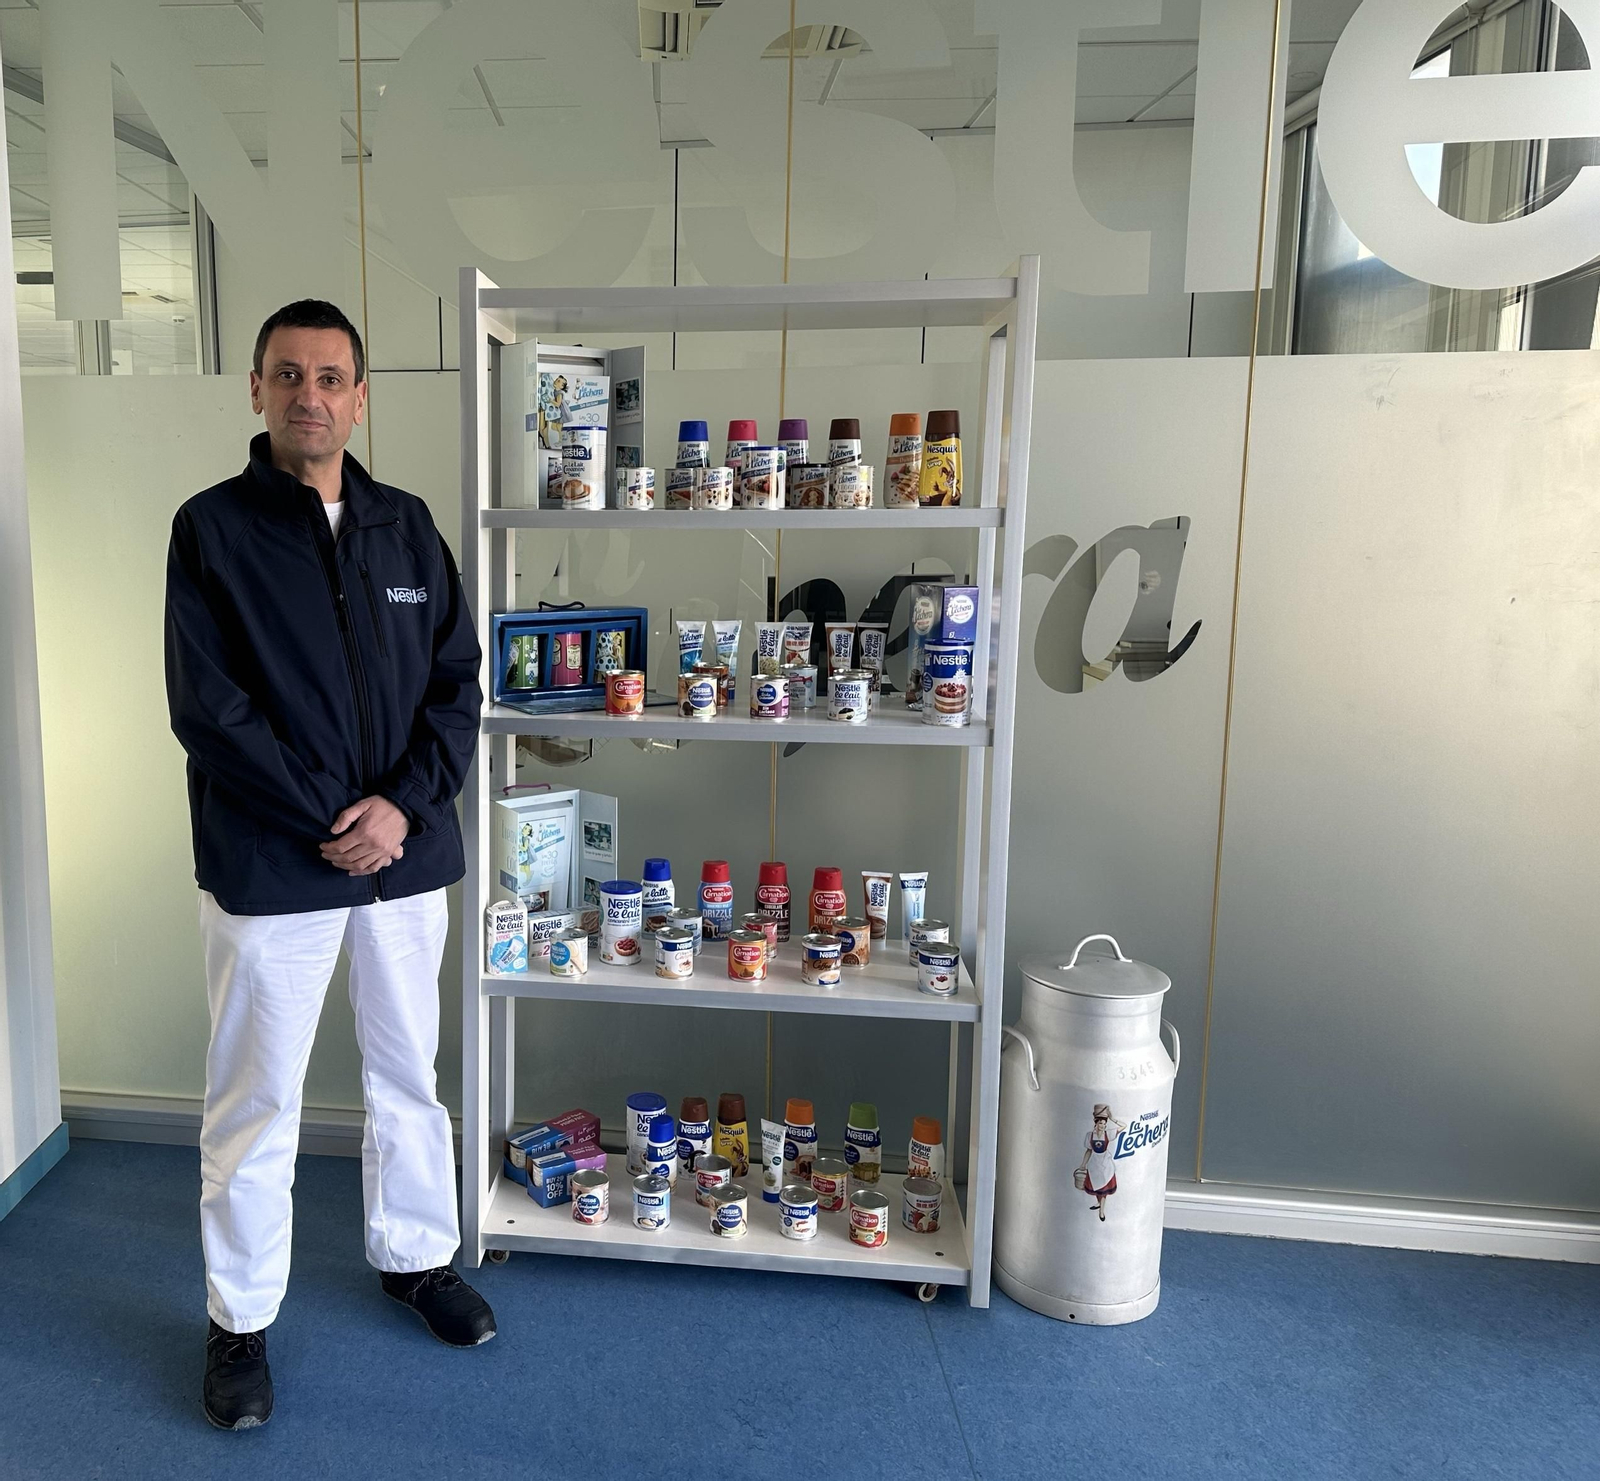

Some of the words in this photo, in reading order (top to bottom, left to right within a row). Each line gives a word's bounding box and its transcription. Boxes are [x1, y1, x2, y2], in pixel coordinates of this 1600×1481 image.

[927, 445, 958, 455] Nesquik
[386, 587, 428, 604] Nestlé
[760, 629, 768, 657] Nestlé
[933, 654, 968, 666] Nestlé
[835, 684, 861, 692] Nestlé
[651, 888, 668, 897] latte
[704, 890, 732, 899] Carnation
[759, 889, 789, 899] Carnation
[608, 897, 640, 909] Nestlé
[816, 895, 845, 905] Carnation
[496, 912, 524, 923] Nestlé
[608, 909, 620, 918] le
[622, 908, 640, 919] lait
[703, 908, 732, 917] DRIZZLE
[507, 920, 524, 929] lait
[533, 919, 562, 932] Nestlé
[734, 947, 761, 957] Carnation
[681, 1125, 707, 1134] Nestlé
[719, 1127, 745, 1136] Nesquik
[785, 1126, 813, 1138] Nestlé
[1128, 1121, 1144, 1135] La
[847, 1129, 875, 1142] Nestlé
[1113, 1114, 1169, 1160] Lechera
[546, 1181, 563, 1192] 10%
[547, 1189, 563, 1200] OFF
